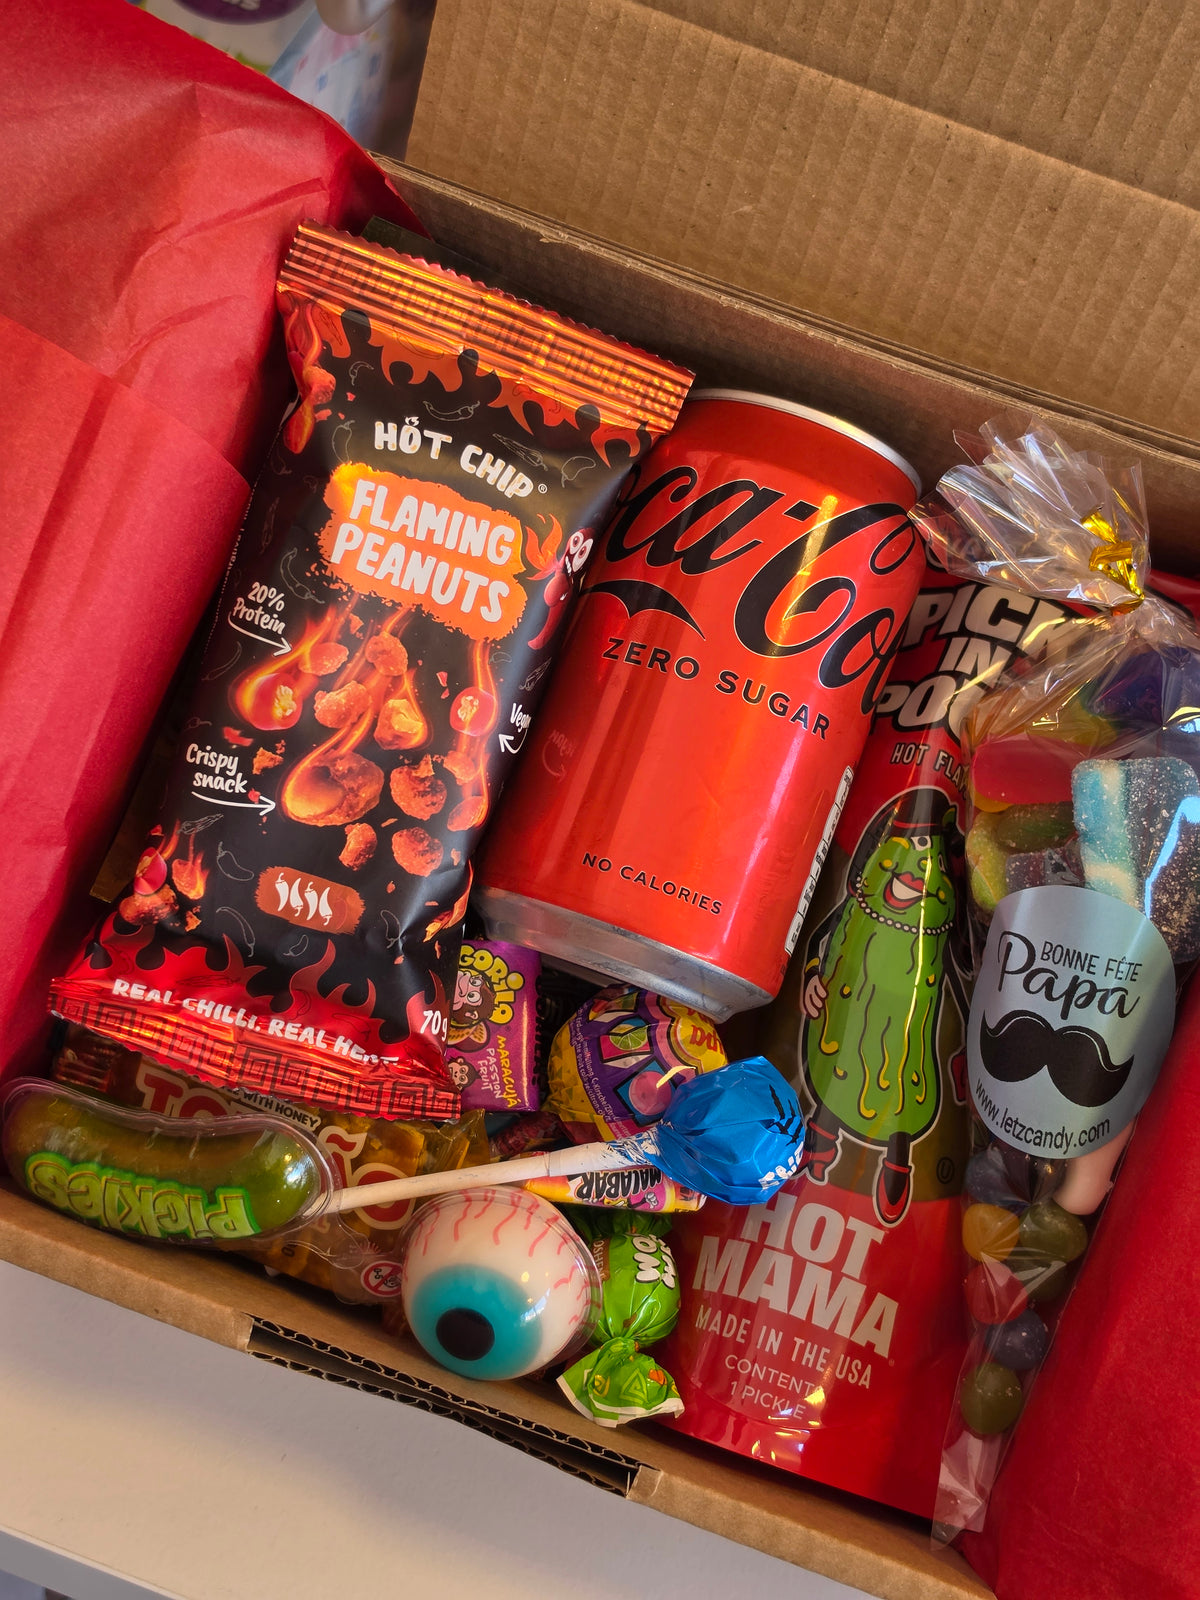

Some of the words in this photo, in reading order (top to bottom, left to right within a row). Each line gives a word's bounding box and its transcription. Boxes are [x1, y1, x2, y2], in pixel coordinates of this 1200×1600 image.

[373, 417, 453, 460] HOT
[347, 478, 516, 567] FLAMING
[246, 581, 287, 613] 20%
[331, 523, 511, 623] PEANUTS
[232, 598, 287, 636] Protein
[602, 636, 700, 681] ZERO
[715, 669, 830, 740] SUGAR
[938, 637, 1012, 689] IN
[185, 743, 241, 777] Crispy
[891, 744, 929, 765] HOT
[192, 769, 248, 795] snack
[582, 852, 612, 872] NO
[620, 865, 723, 916] CALORIES
[997, 930, 1141, 1021] Papa
[1040, 940, 1100, 976] BONNE
[1104, 955, 1143, 983] FÊTE
[112, 978, 176, 1007] REAL
[182, 998, 262, 1032] CHILLI.
[267, 1018, 328, 1049] REAL
[333, 1037, 400, 1066] HE
[477, 1059, 494, 1092] FRUIT
[485, 1047, 503, 1100] PASSION
[496, 1034, 522, 1109] MARACUJÁ
[243, 1089, 273, 1110] WITH
[275, 1101, 319, 1129] HONEY
[976, 1078, 1111, 1155] www.letzcandy.com
[573, 1167, 663, 1200] MALABAR
[740, 1192, 886, 1279] HOT
[692, 1235, 899, 1359] MAMA
[695, 1304, 751, 1345] MADE
[757, 1324, 783, 1356] IN
[791, 1336, 836, 1374] THE
[835, 1353, 873, 1390] USA
[724, 1354, 822, 1399] CONTENT
[730, 1380, 739, 1396] 1
[741, 1384, 807, 1420] PICKLE
